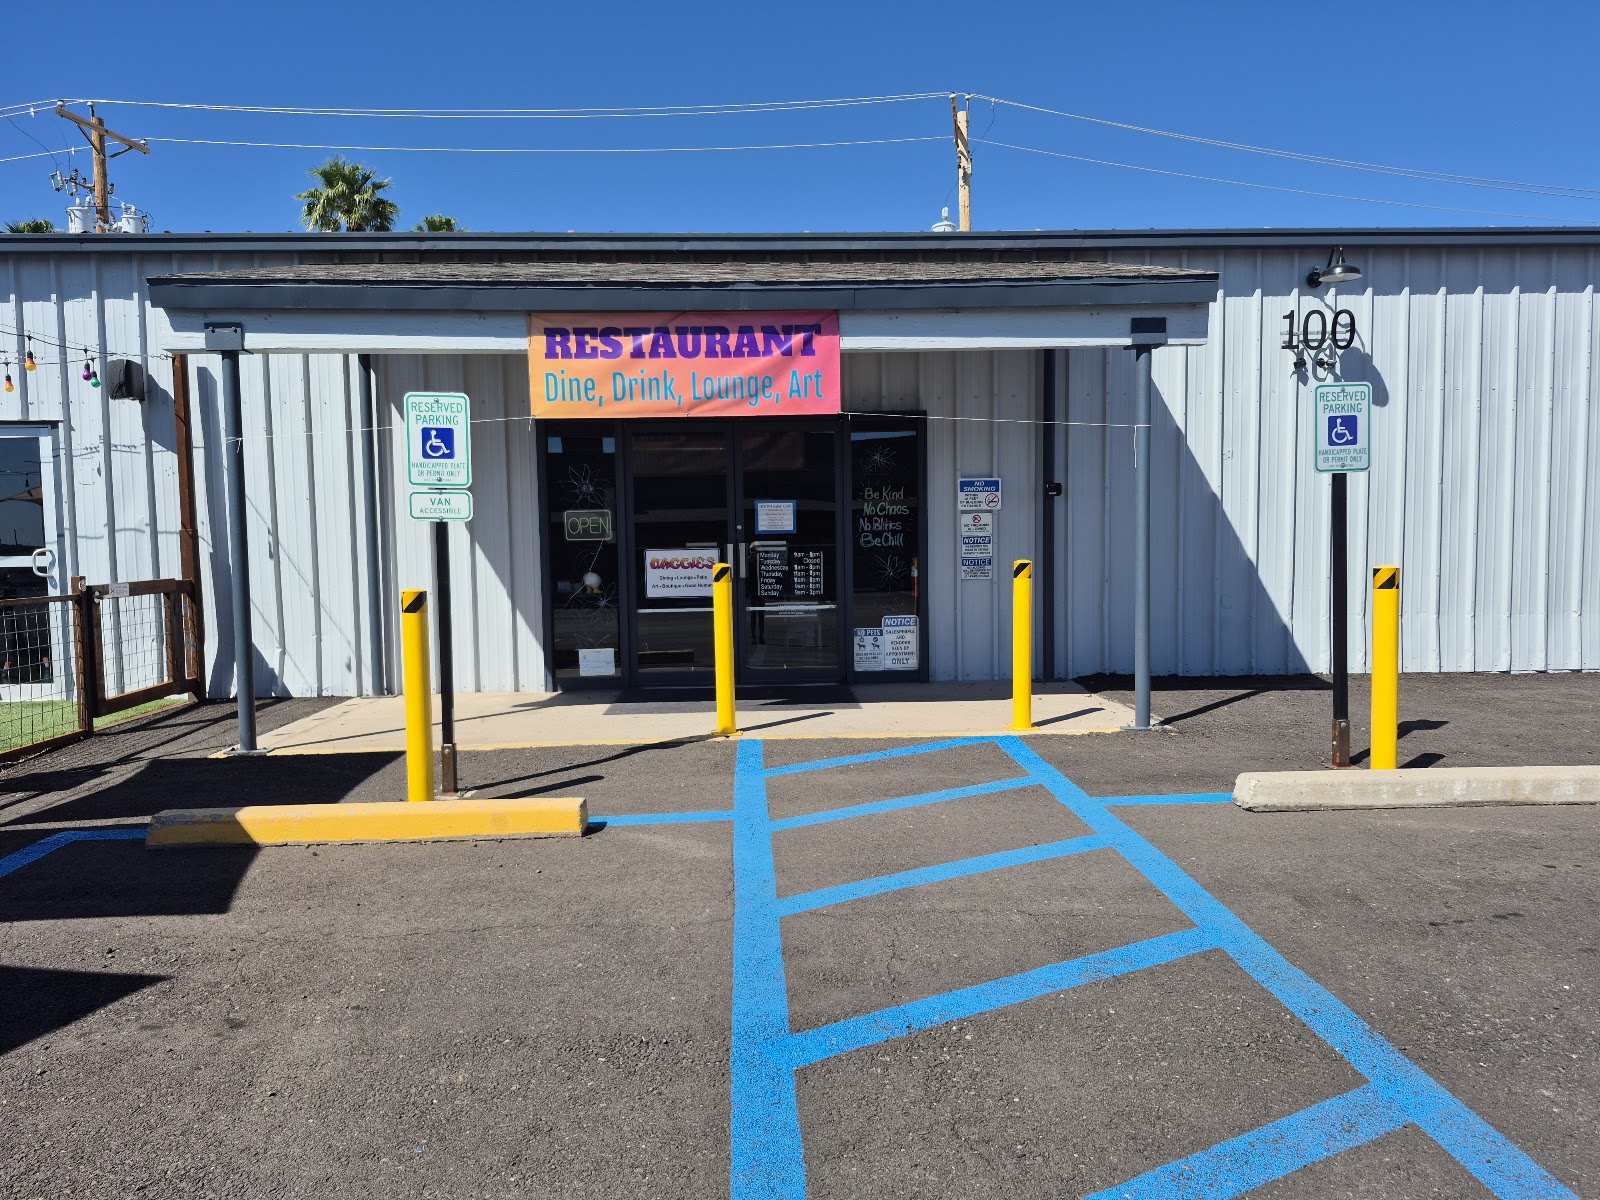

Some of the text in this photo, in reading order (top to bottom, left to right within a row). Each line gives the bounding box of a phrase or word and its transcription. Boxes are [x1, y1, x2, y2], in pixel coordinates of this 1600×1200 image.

[1281, 309, 1356, 350] 100
[543, 324, 822, 360] RESTAURANT
[545, 367, 824, 407] Dine, Drink, Lounge, Art
[1319, 390, 1366, 402] RESERVED
[411, 401, 463, 414] RESERVED
[1323, 402, 1362, 414] PARKING
[415, 414, 459, 426] PARKING
[1318, 447, 1367, 456] HANDICAPPED PLATE
[1322, 455, 1363, 464] OR PERMIT ONLY
[417, 469, 425, 477] OR
[864, 485, 904, 501] Be Kind
[430, 497, 451, 506] VAN
[863, 501, 910, 516] No Chaos
[567, 516, 610, 534] OPEN
[859, 516, 902, 532] No Politics
[859, 531, 904, 547] Be Chill
[963, 536, 991, 544] NOTICE
[963, 558, 990, 566] NOTICE
[884, 617, 916, 626] NOTICE
[891, 657, 910, 665] ONLY
